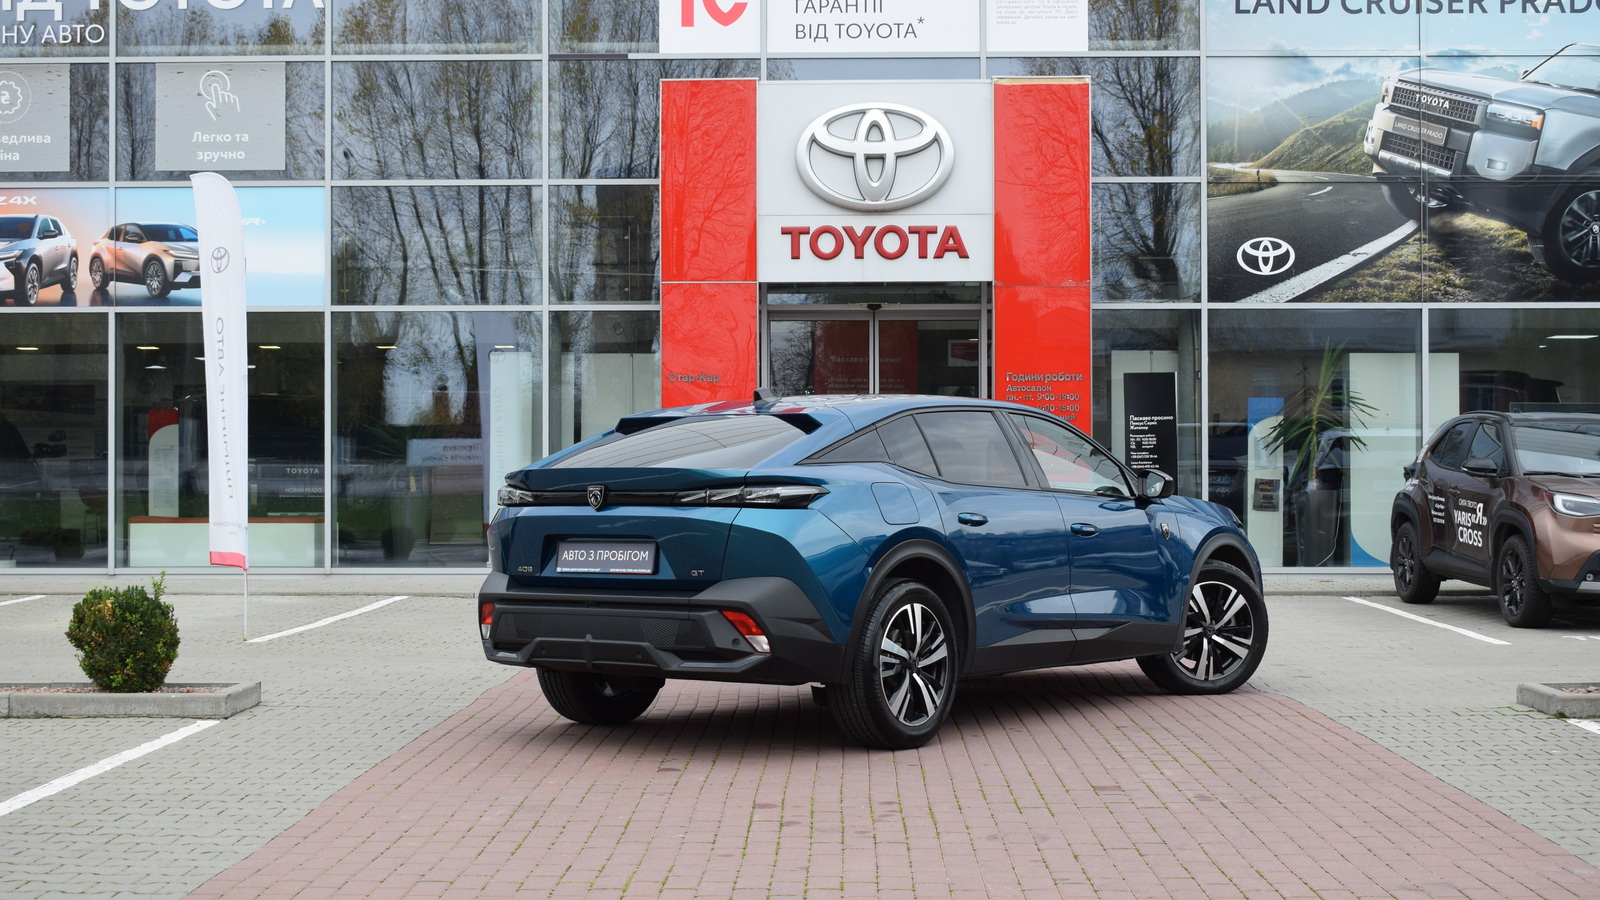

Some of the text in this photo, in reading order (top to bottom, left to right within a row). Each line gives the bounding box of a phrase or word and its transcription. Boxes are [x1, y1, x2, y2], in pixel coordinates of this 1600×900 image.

[1500, 0, 1600, 14] PRAD
[2, 24, 105, 44] НУ АВТО
[795, 23, 829, 42] ВІД
[1415, 94, 1450, 109] TOYOTA
[1394, 121, 1443, 139] LAND CRUISER PRADO
[0, 134, 51, 145] едлива
[192, 132, 249, 143] Легко та
[196, 150, 245, 163] зручно
[780, 225, 970, 260] TOYOTA
[668, 373, 720, 384] Стар-Кар
[1006, 372, 1083, 383] Години роботи
[1006, 384, 1052, 392] Автосалон
[1453, 509, 1472, 527] YARIS
[1458, 526, 1483, 547] CROSS
[562, 550, 587, 561] АВТО
[596, 550, 649, 561] ПРОБІГОМ
